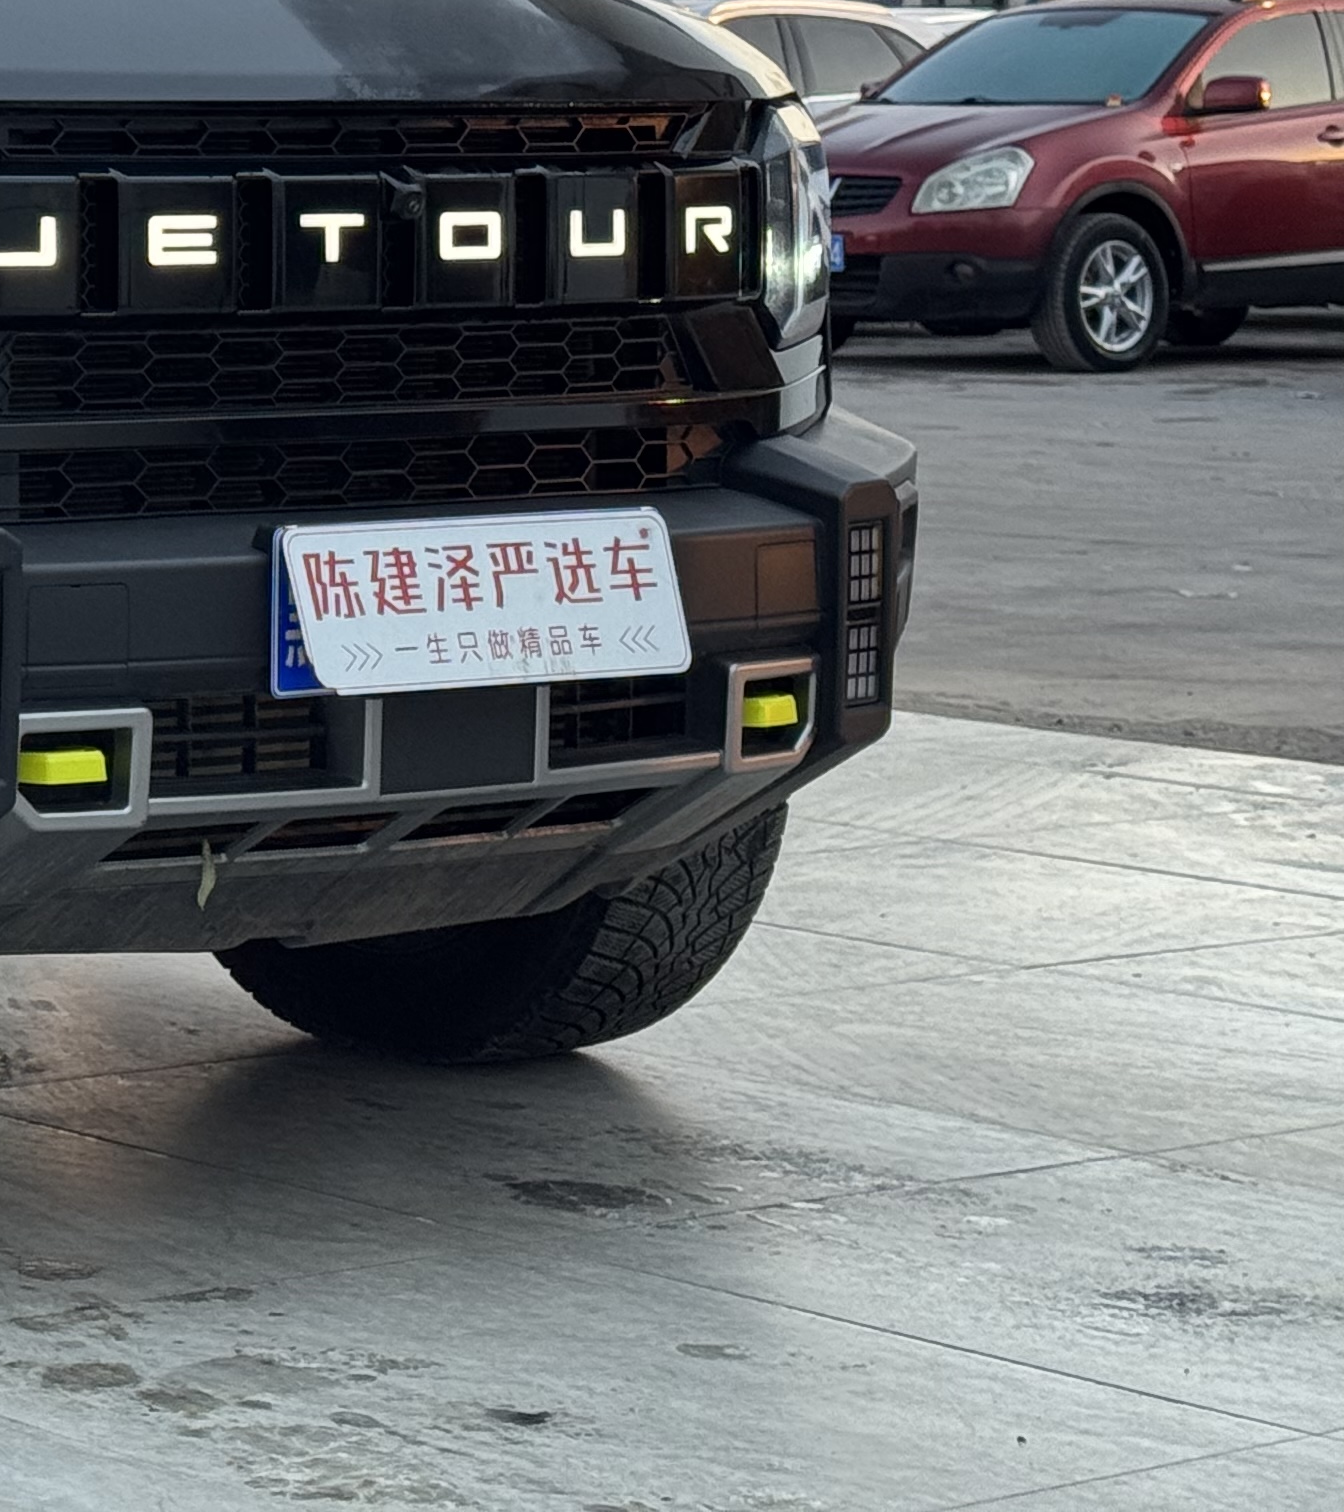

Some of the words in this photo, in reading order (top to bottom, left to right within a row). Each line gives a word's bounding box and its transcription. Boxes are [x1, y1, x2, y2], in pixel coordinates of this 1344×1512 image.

[301, 537, 659, 622] 陈建泽严选车
[394, 623, 603, 665] 一生只做精品车
